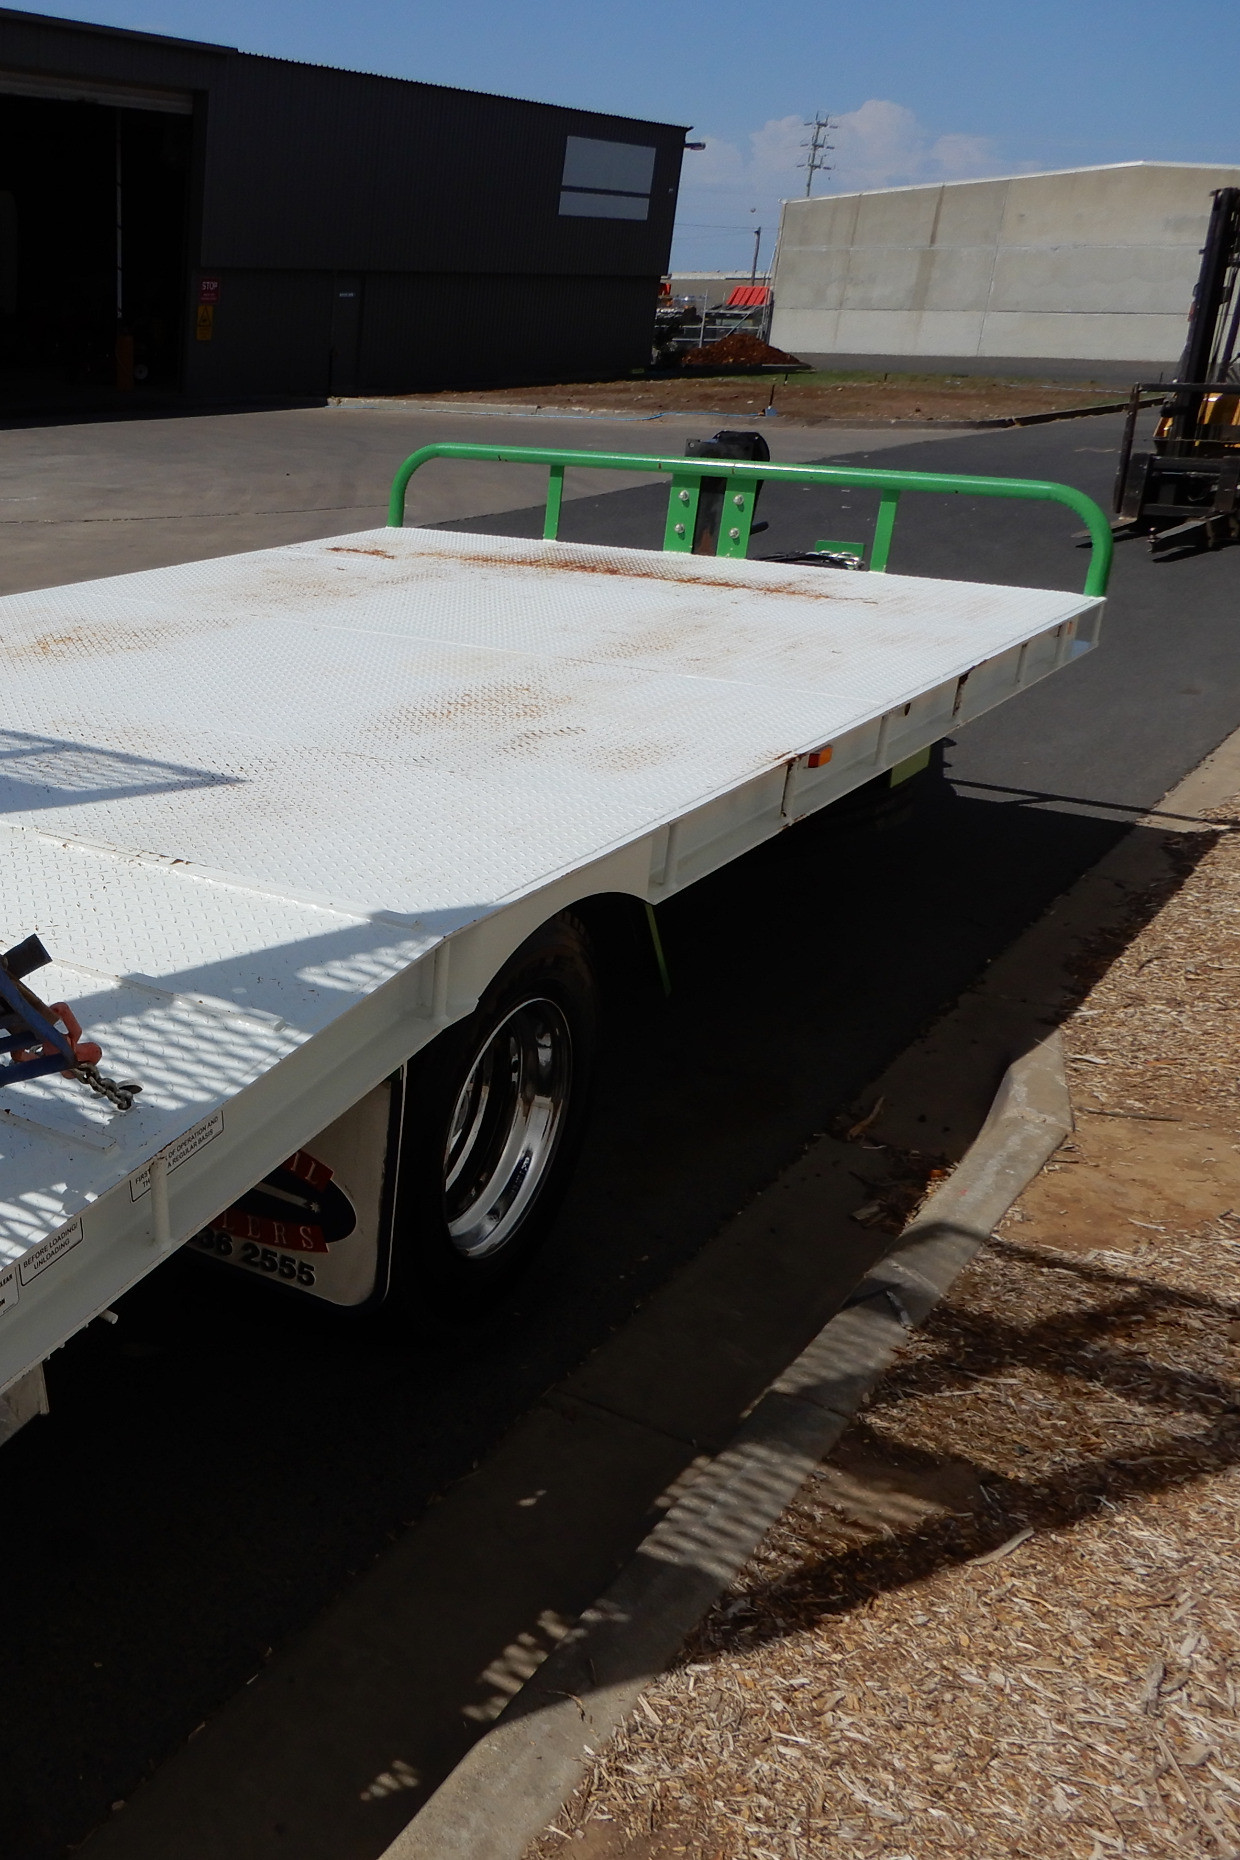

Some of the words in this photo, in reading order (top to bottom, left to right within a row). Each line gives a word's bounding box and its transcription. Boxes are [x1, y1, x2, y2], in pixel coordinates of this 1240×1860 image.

[201, 281, 219, 291] STOP
[135, 1167, 151, 1184] FIRST
[168, 1149, 176, 1159] OF
[176, 1125, 206, 1151] OPERATION
[207, 1116, 219, 1128] AND
[172, 1141, 198, 1165] REGULAR
[198, 1129, 214, 1144] BASIS
[23, 1244, 48, 1268] BEFORE
[33, 1238, 70, 1269] UNLOADING
[241, 1242, 316, 1286] 2555
